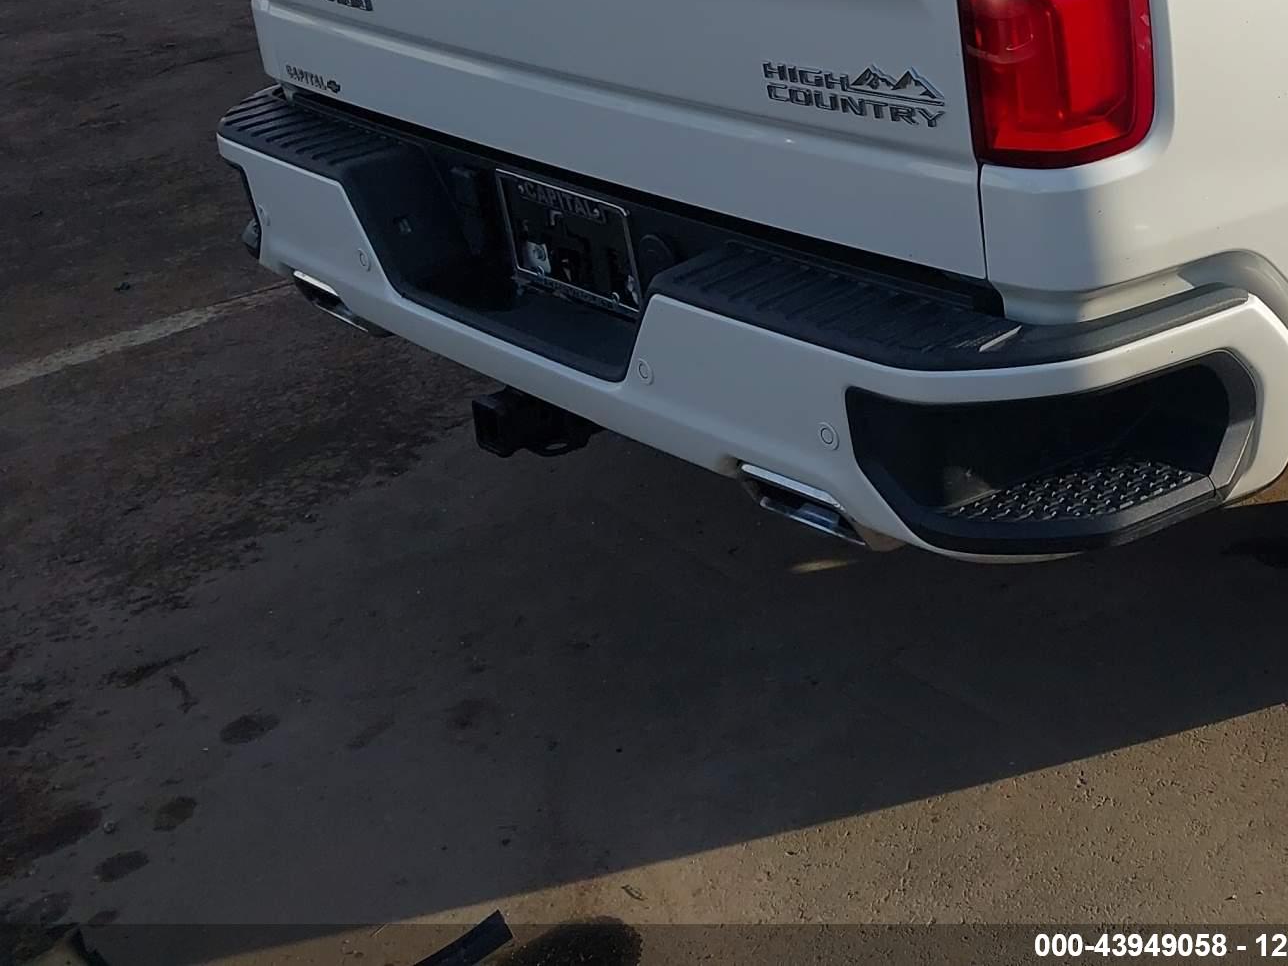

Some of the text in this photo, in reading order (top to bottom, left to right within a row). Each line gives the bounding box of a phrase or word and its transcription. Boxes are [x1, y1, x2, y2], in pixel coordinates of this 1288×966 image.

[285, 64, 327, 91] CAPITAL
[762, 60, 851, 93] HIGH
[765, 83, 947, 128] COUNTRY
